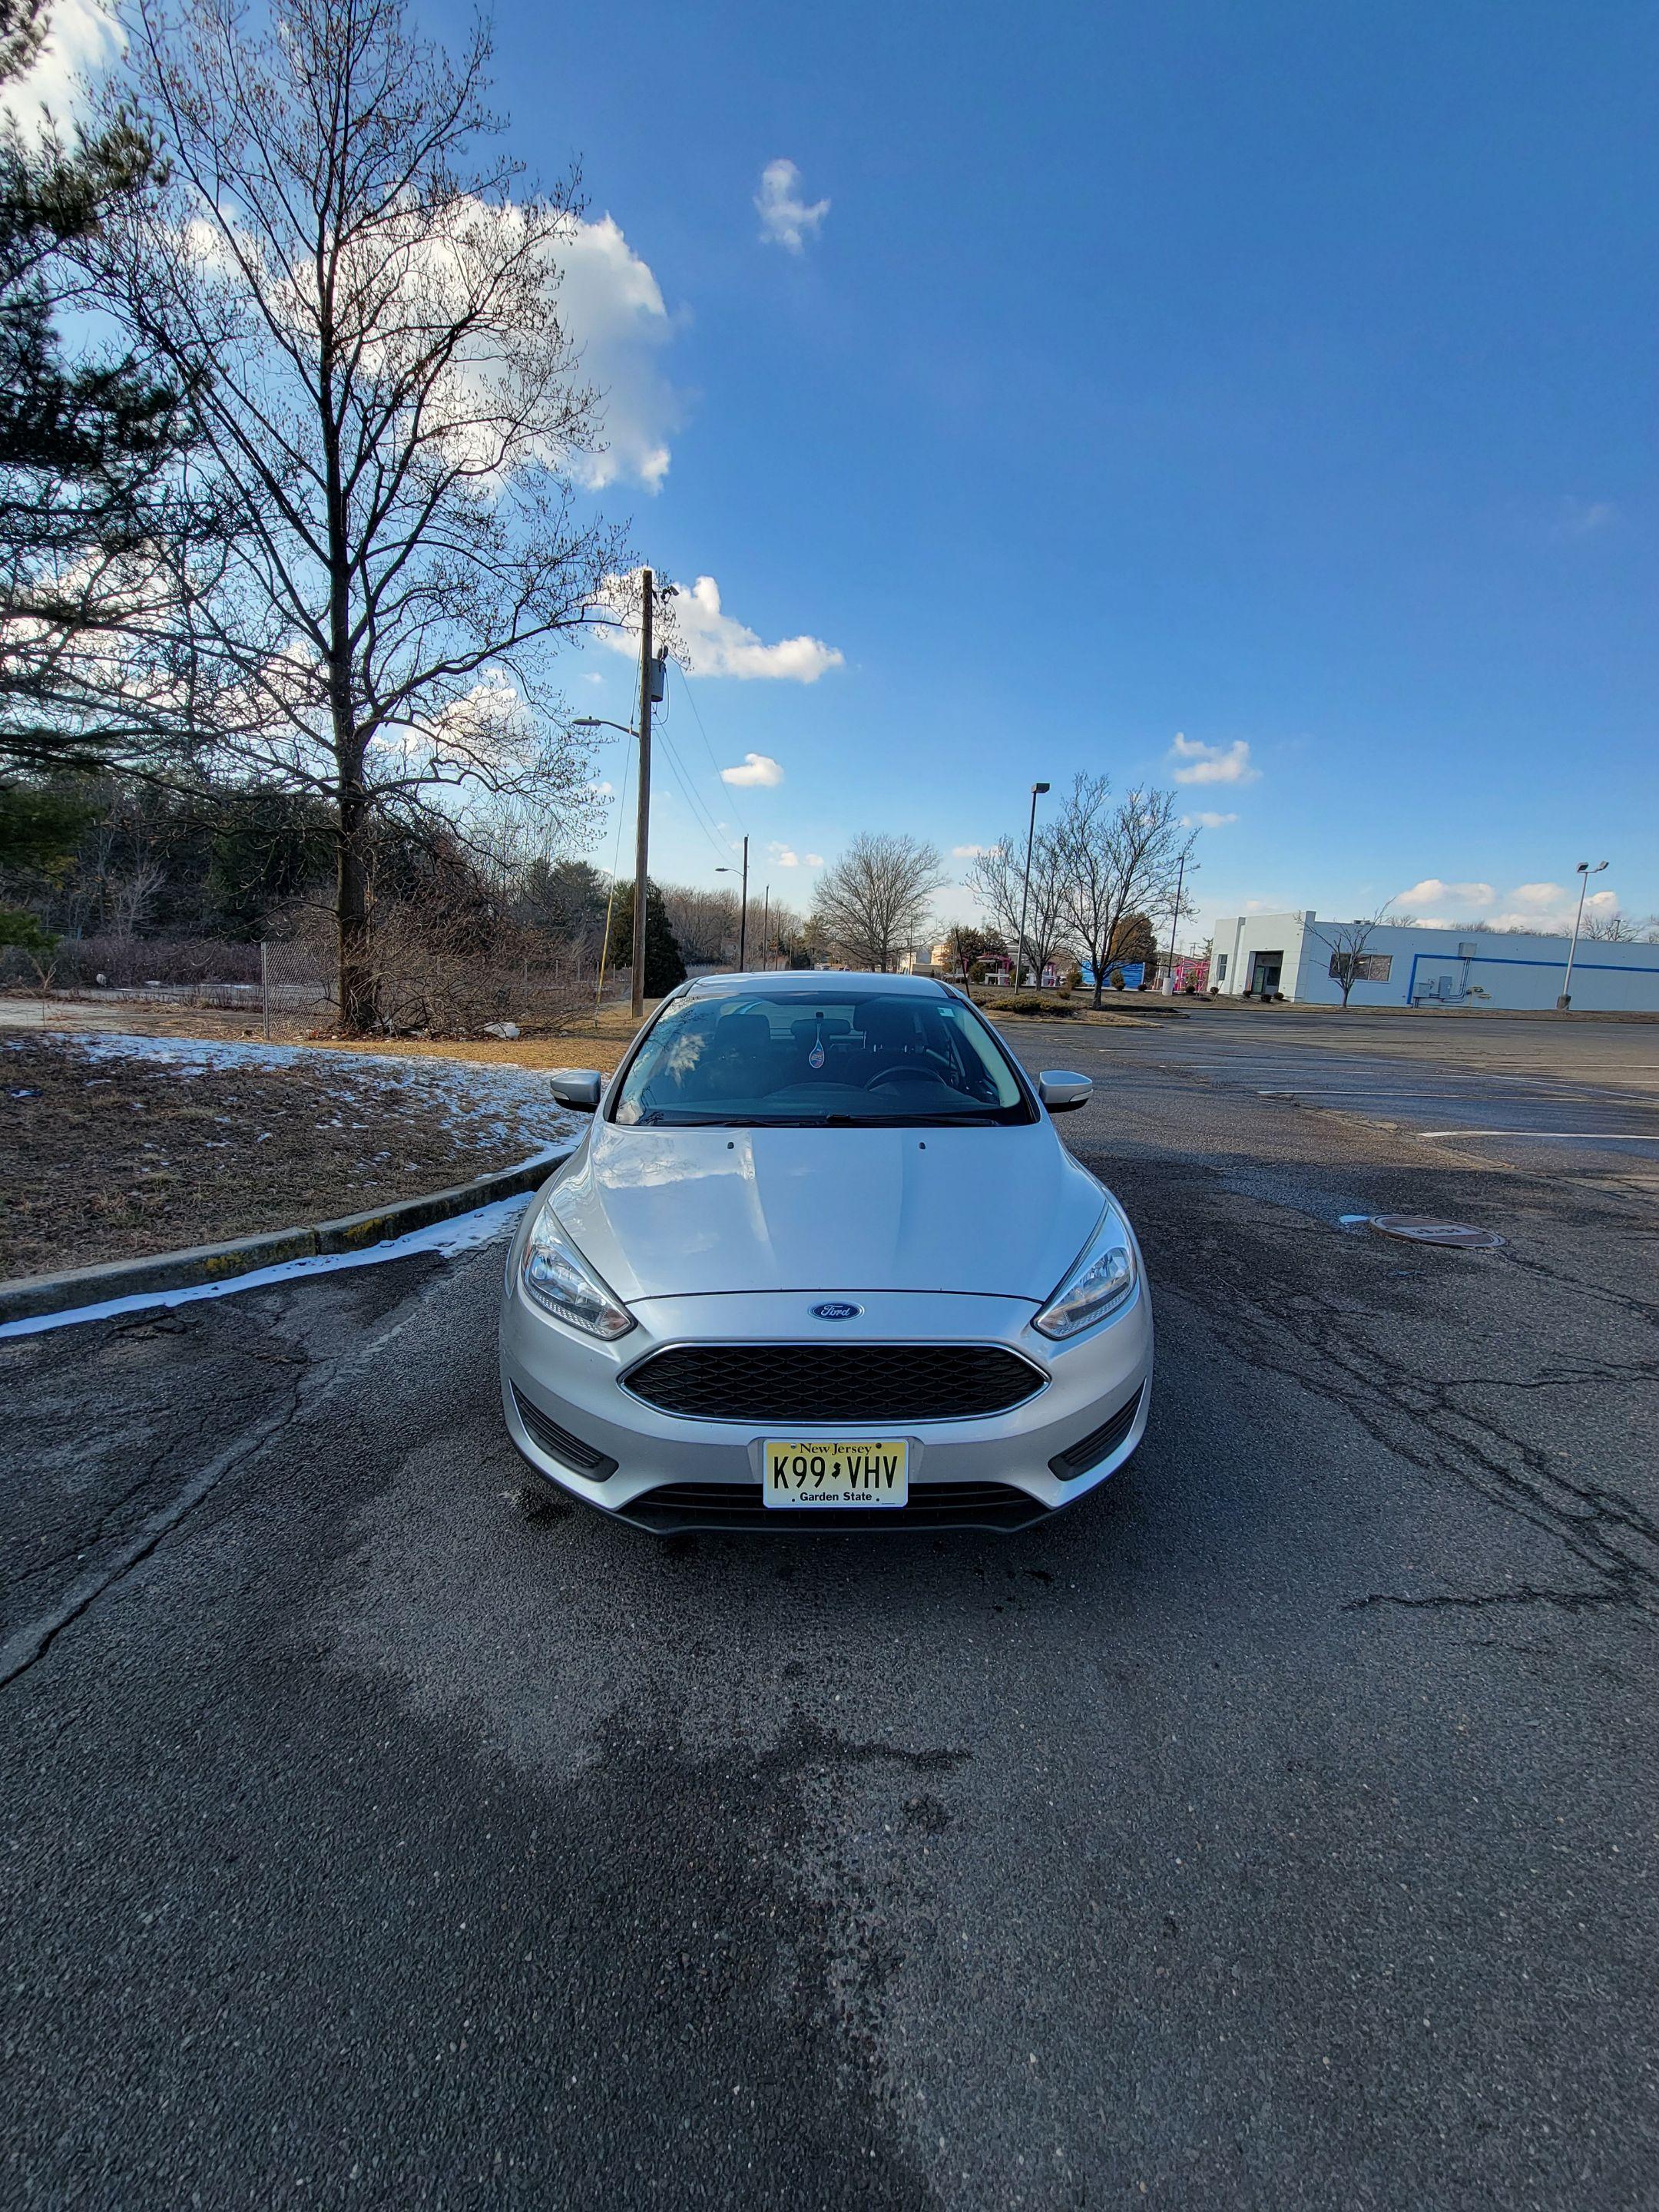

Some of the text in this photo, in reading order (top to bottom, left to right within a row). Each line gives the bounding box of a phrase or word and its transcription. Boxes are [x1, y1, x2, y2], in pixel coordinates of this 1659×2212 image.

[820, 1304, 851, 1316] Ford
[800, 1443, 872, 1455] New Jersey
[773, 1456, 898, 1489] K99 VHV
[800, 1492, 873, 1502] Garden State
